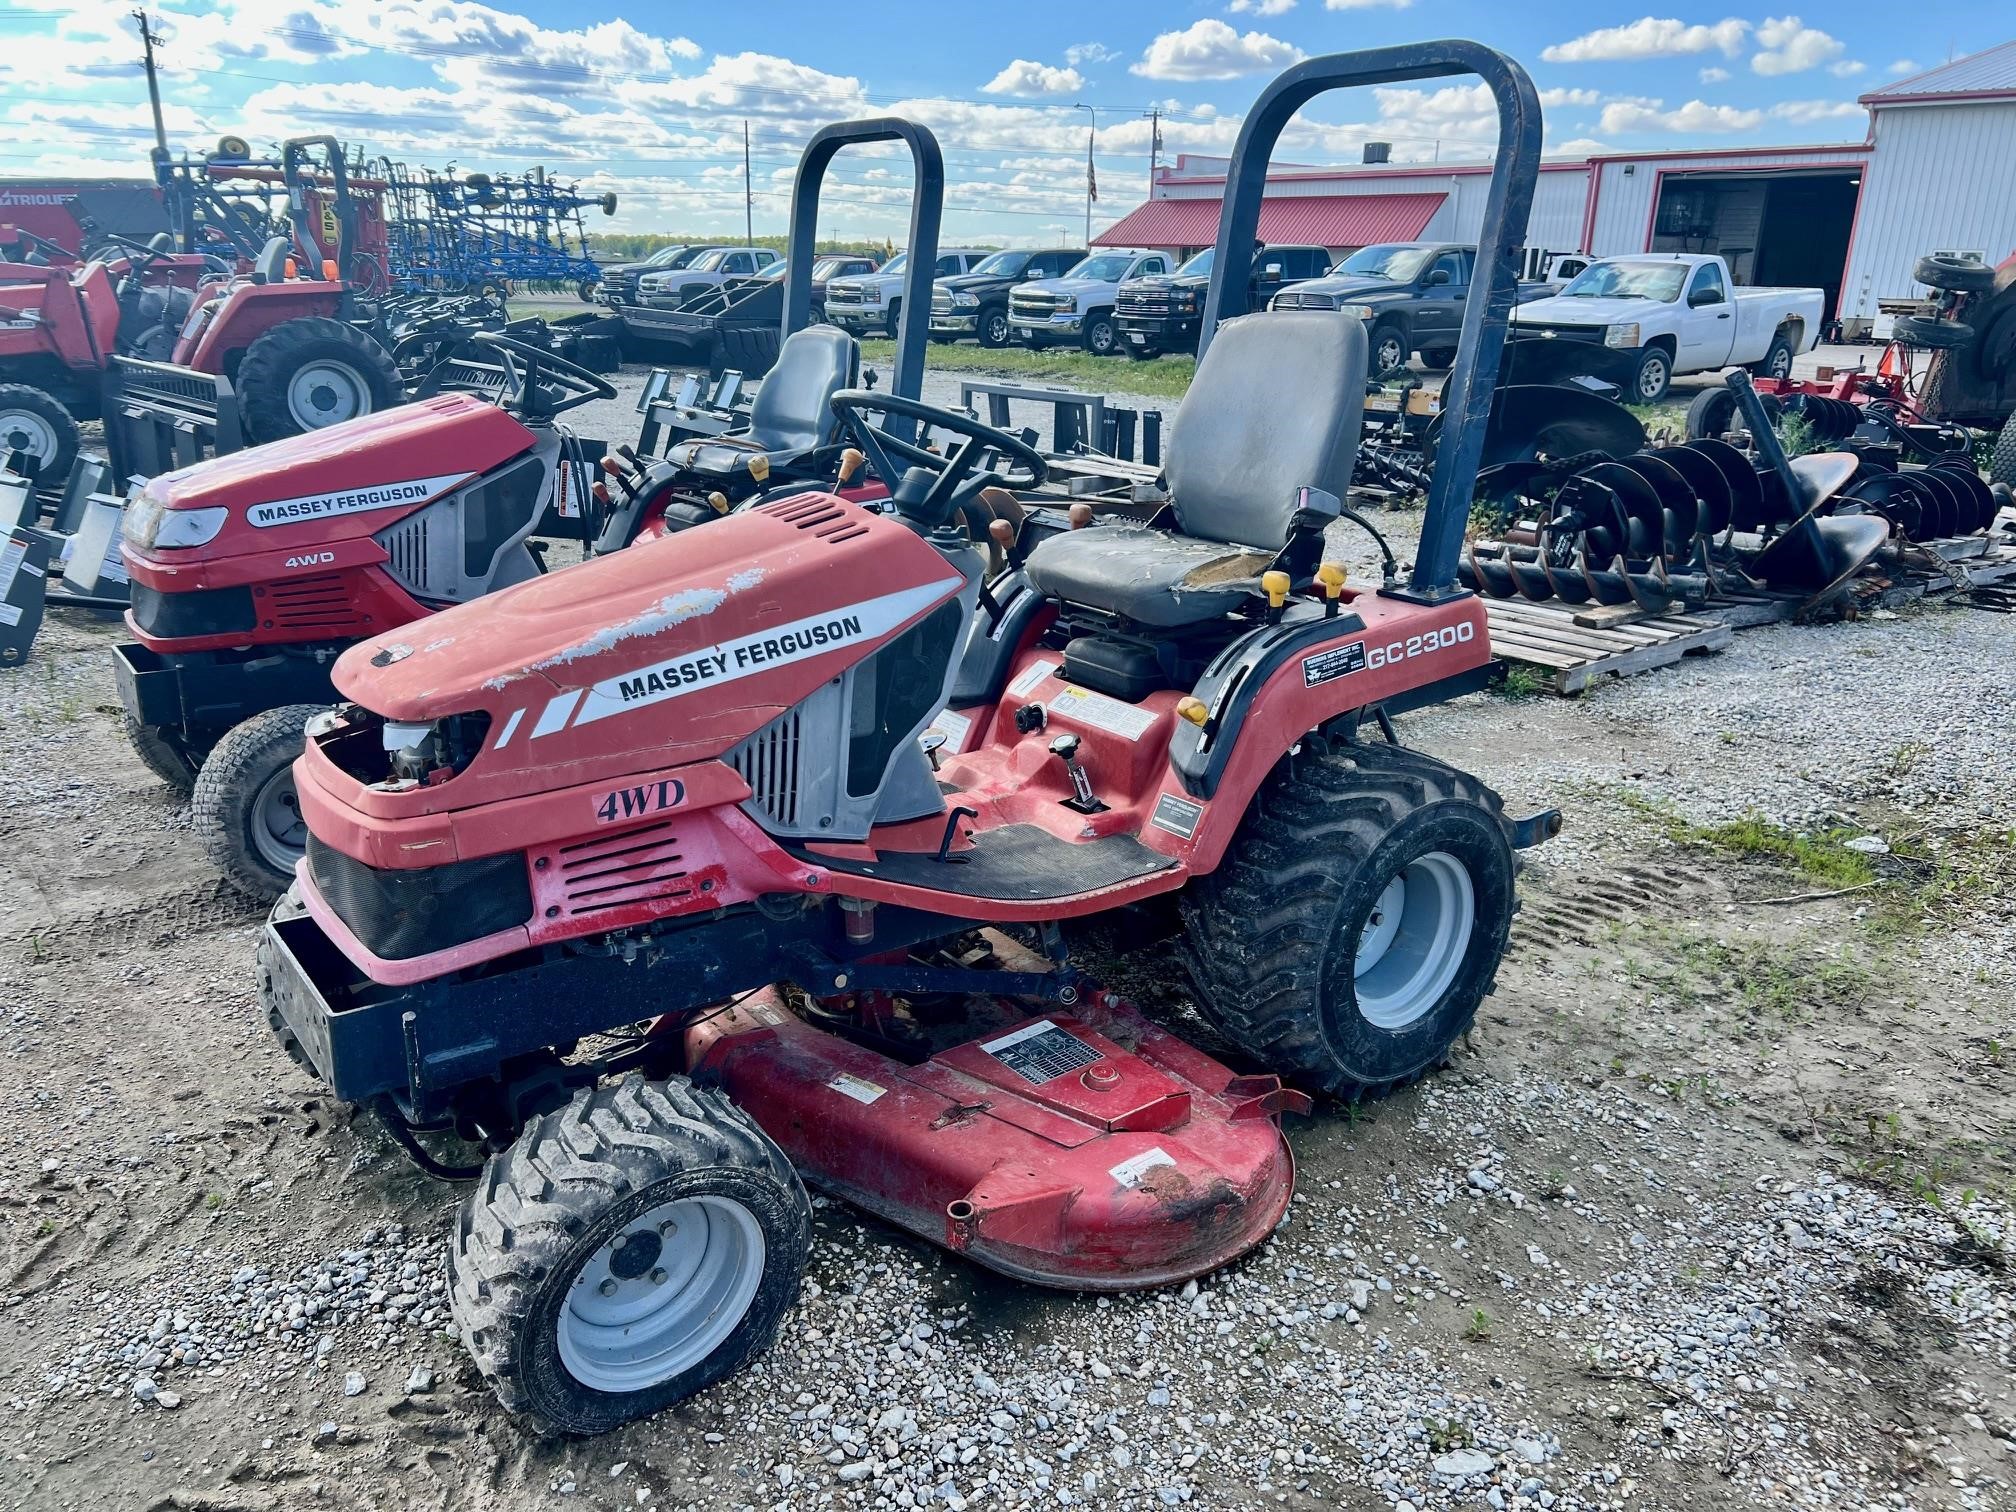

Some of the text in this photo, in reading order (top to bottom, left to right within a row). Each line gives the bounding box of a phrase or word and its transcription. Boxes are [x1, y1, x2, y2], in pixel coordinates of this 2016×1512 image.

[258, 484, 428, 522] MASSEY FERGUSON
[285, 551, 335, 568] 4WD
[618, 615, 862, 702] MASSEY FERGUSON
[597, 779, 685, 821] 4WD
